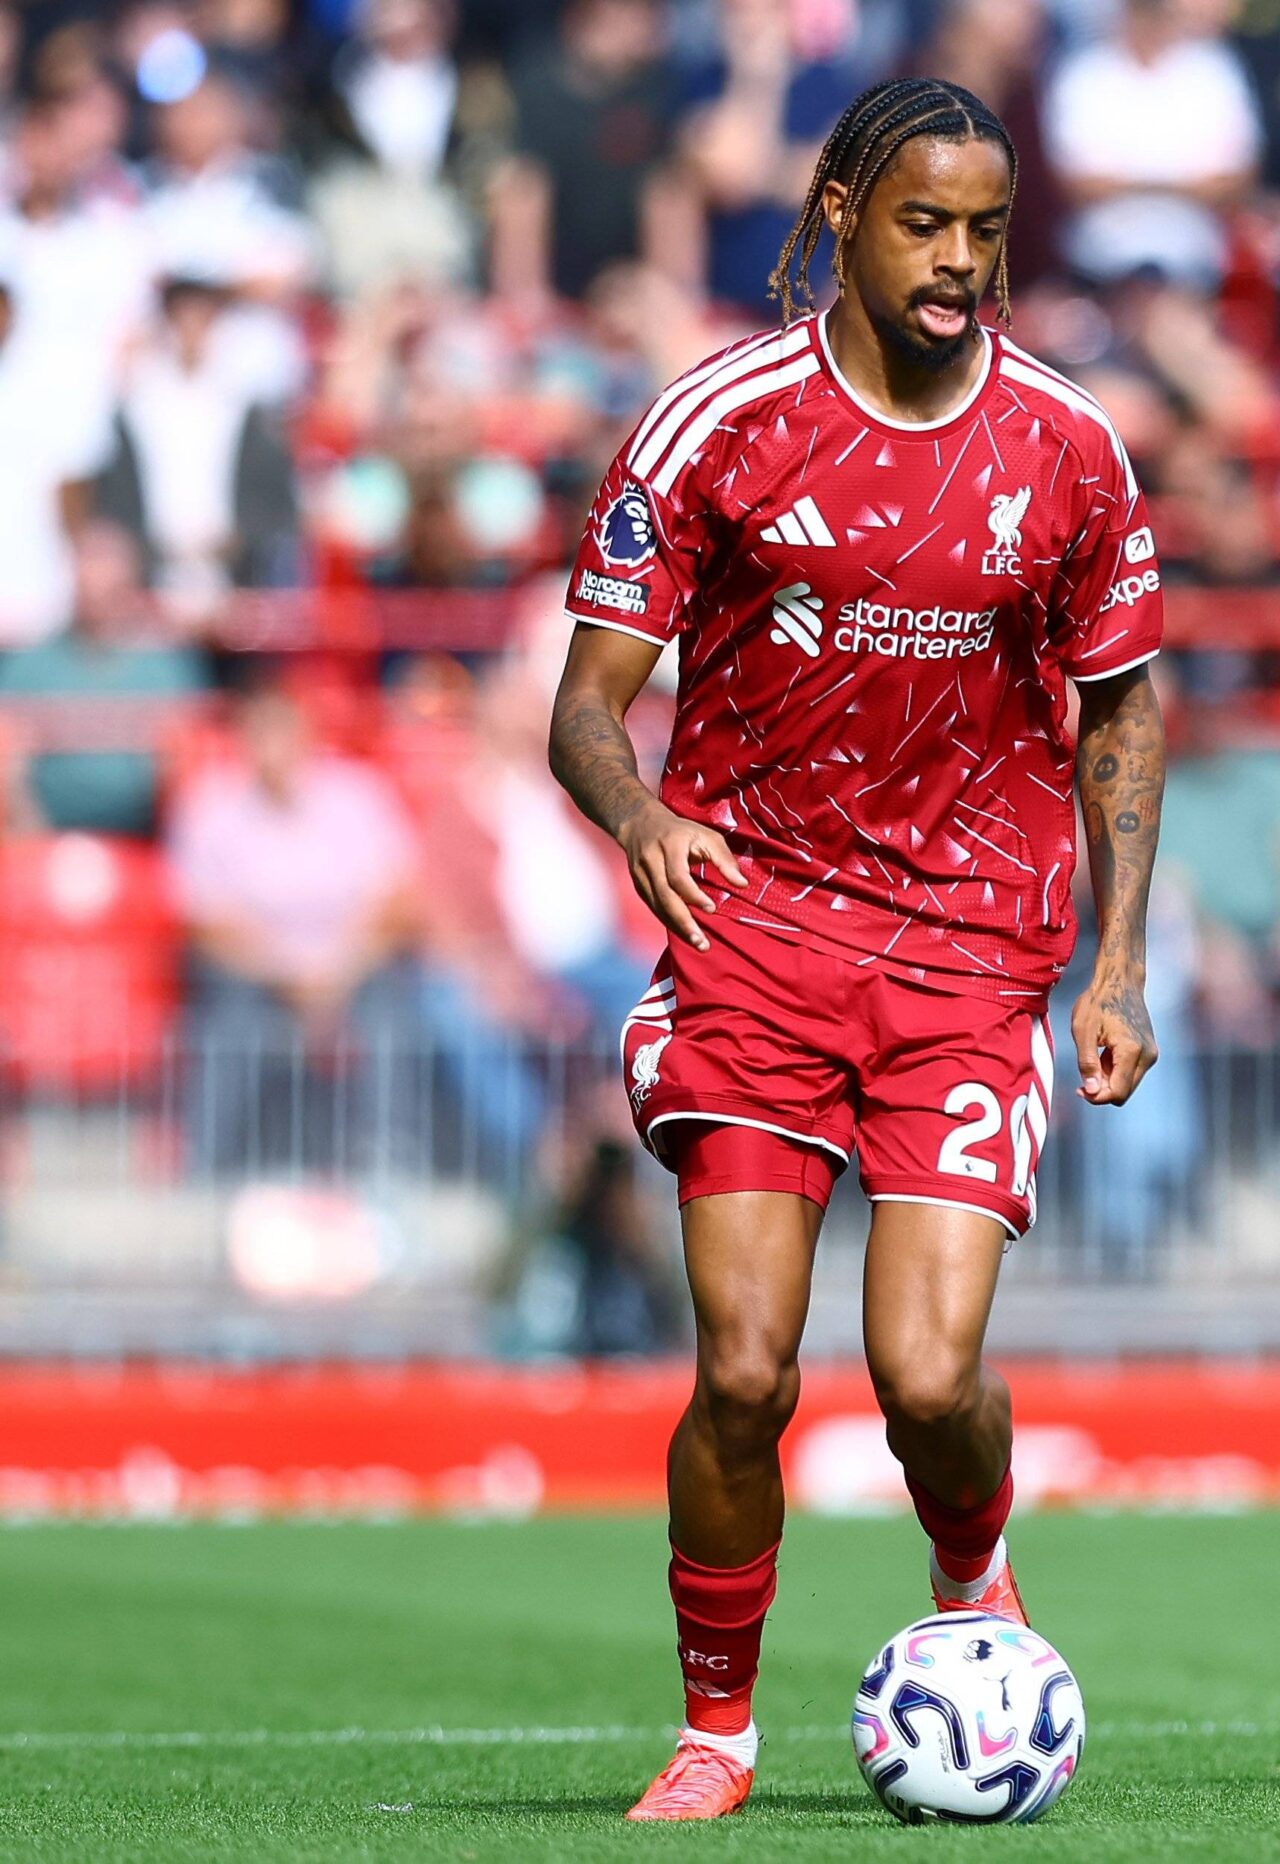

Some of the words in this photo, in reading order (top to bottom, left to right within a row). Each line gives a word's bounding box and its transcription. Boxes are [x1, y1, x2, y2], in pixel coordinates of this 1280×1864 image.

[582, 568, 599, 587] No
[597, 577, 643, 600] room
[838, 598, 999, 634] standard
[833, 625, 995, 660] chartered
[682, 1648, 729, 1671] FC
